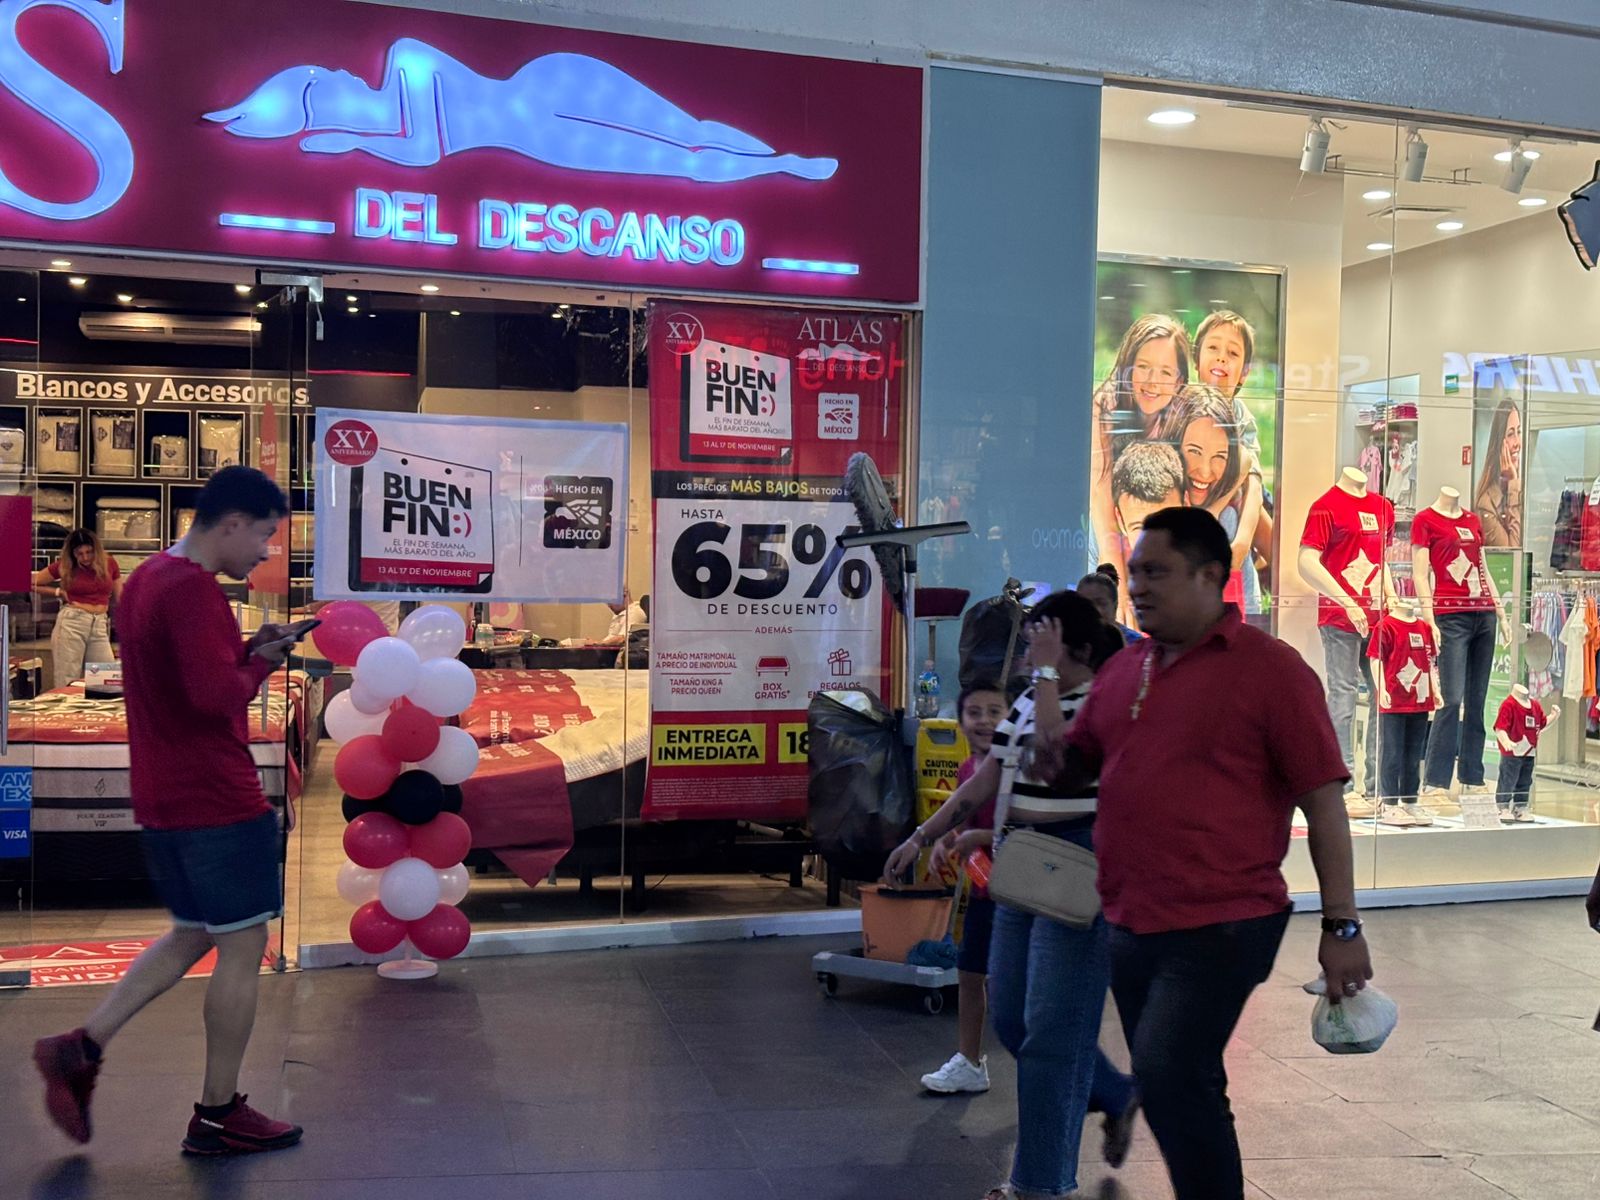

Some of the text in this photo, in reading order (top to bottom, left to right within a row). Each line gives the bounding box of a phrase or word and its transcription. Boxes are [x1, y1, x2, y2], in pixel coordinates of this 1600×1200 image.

[355, 187, 746, 267] DEL DESCANSO
[666, 322, 698, 340] XV
[796, 316, 883, 344] ATLAS
[705, 358, 776, 392] BUEN
[16, 373, 308, 405] Blancos y Accesorios
[708, 423, 722, 431] MÁS
[743, 419, 770, 427] SEMANA
[824, 425, 853, 434] MÉXICO
[332, 429, 373, 449] XV
[330, 448, 375, 456] ANIVERSARIO
[737, 443, 776, 451] NOVIEMBRE
[383, 471, 472, 510] BUEN
[555, 484, 588, 495] HECHO
[591, 485, 603, 495] EN
[676, 482, 692, 491] LOS
[693, 483, 727, 492] PRECIOS
[730, 475, 762, 493] MÁS
[765, 481, 808, 497] BAJOS
[809, 487, 820, 495] DE
[821, 488, 842, 496] TODO
[681, 508, 724, 519] HASTA
[553, 525, 601, 541] MÉXICO
[393, 539, 465, 550] EL FIN DE SEMANA
[384, 546, 402, 555] MÁS
[405, 547, 438, 557] BARATO
[456, 549, 476, 558] AÑO
[671, 521, 872, 600] 65%
[378, 566, 386, 574] 13
[423, 568, 472, 577] NOVIEMBRE
[708, 603, 838, 615] DE DESCUENTO
[657, 651, 736, 660] TAMAÑO MATRIMONIAL
[670, 677, 701, 686] TAMAÑO
[762, 683, 783, 691] BOX
[820, 681, 862, 690] REGALOS
[698, 687, 721, 695] QUEEN
[666, 729, 752, 744] ENTREGA
[657, 745, 760, 761] INMEDIATA
[925, 759, 959, 769] CAUTION
[922, 768, 959, 778] WET FLOO
[0, 772, 33, 788] AM
[3, 786, 32, 802] EX
[3, 830, 28, 840] VISA
